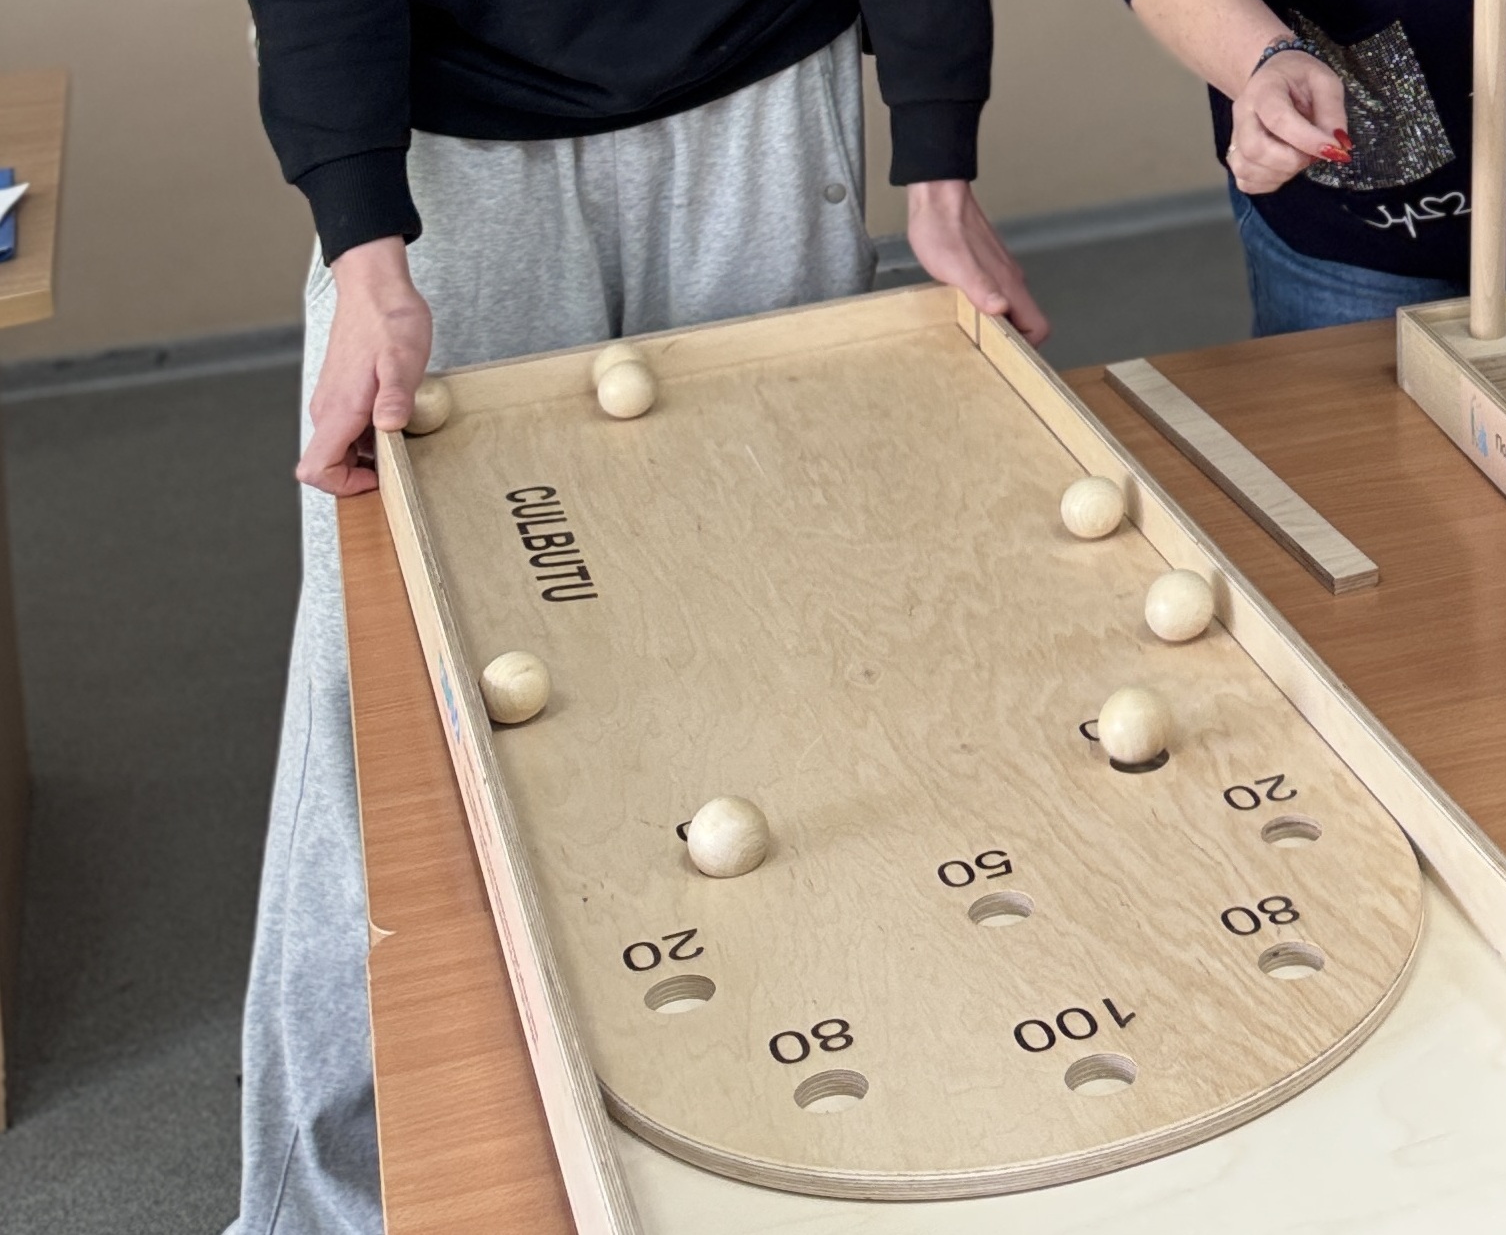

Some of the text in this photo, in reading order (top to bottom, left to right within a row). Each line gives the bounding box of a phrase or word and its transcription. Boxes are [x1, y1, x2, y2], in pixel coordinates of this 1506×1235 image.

[505, 485, 599, 603] CULBUTU
[1222, 773, 1298, 812] 20
[936, 850, 1014, 889] 50
[1219, 894, 1302, 937] 80
[621, 928, 706, 973] 20
[767, 1017, 855, 1066] 80
[1012, 995, 1138, 1054] 100
